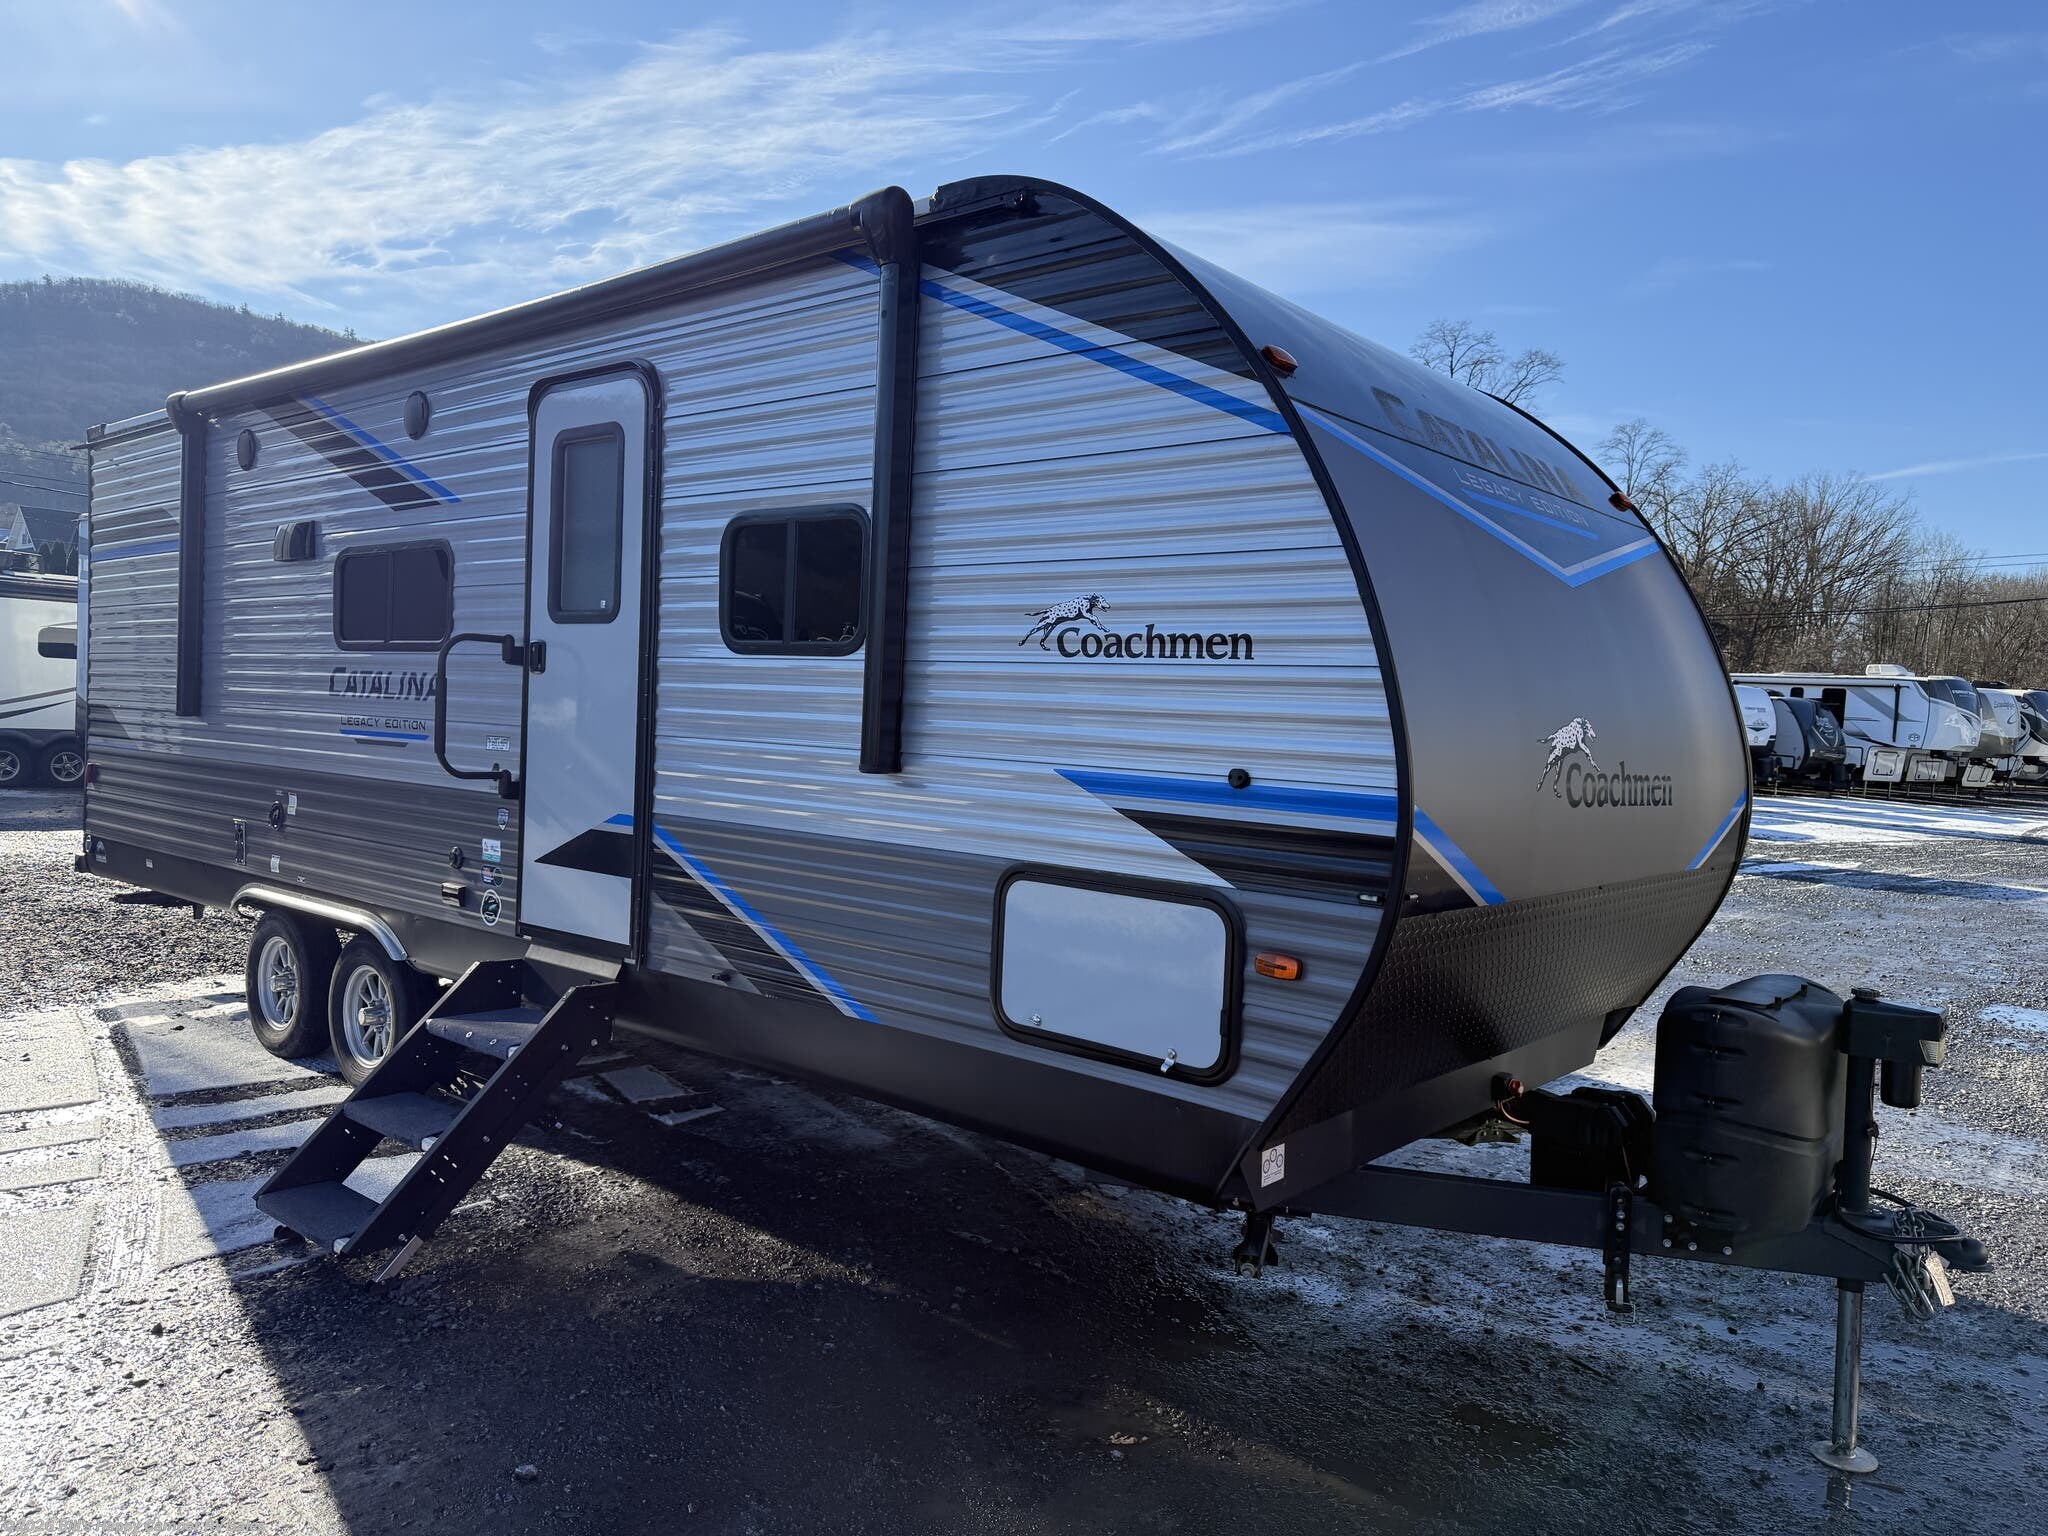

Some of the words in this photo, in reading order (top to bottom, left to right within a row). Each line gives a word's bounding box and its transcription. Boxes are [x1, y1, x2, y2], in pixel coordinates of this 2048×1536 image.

[1371, 386, 1591, 507] CATALINA
[1453, 467, 1524, 504] LEGACY
[1532, 499, 1589, 527] EDITION
[1056, 624, 1255, 660] Coachmen
[340, 715, 381, 728] LEGACY
[384, 718, 426, 731] EDITION
[1565, 760, 1673, 808] Coachmen
